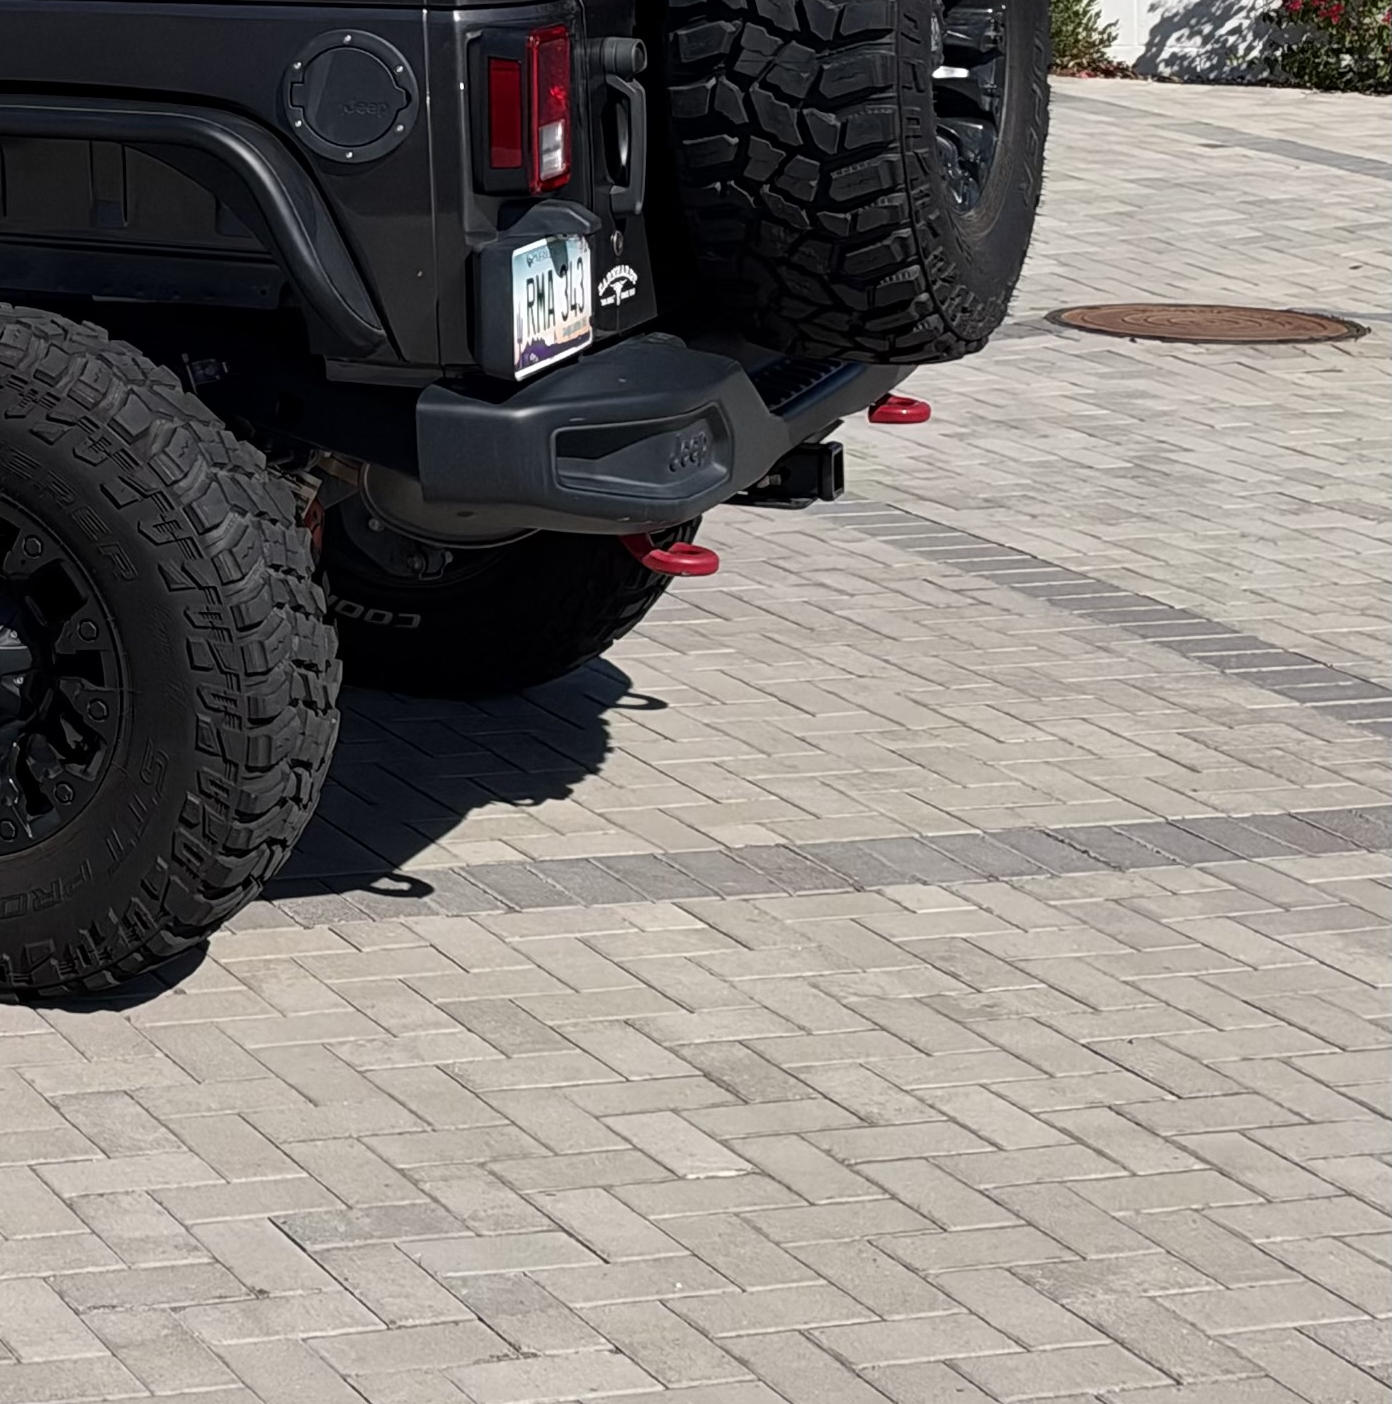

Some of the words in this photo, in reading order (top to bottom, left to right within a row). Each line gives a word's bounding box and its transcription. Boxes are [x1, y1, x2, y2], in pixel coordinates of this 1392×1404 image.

[526, 269, 556, 339] RMA
[560, 256, 585, 322] 343
[668, 435, 707, 473] Jeep
[106, 736, 170, 878] STT
